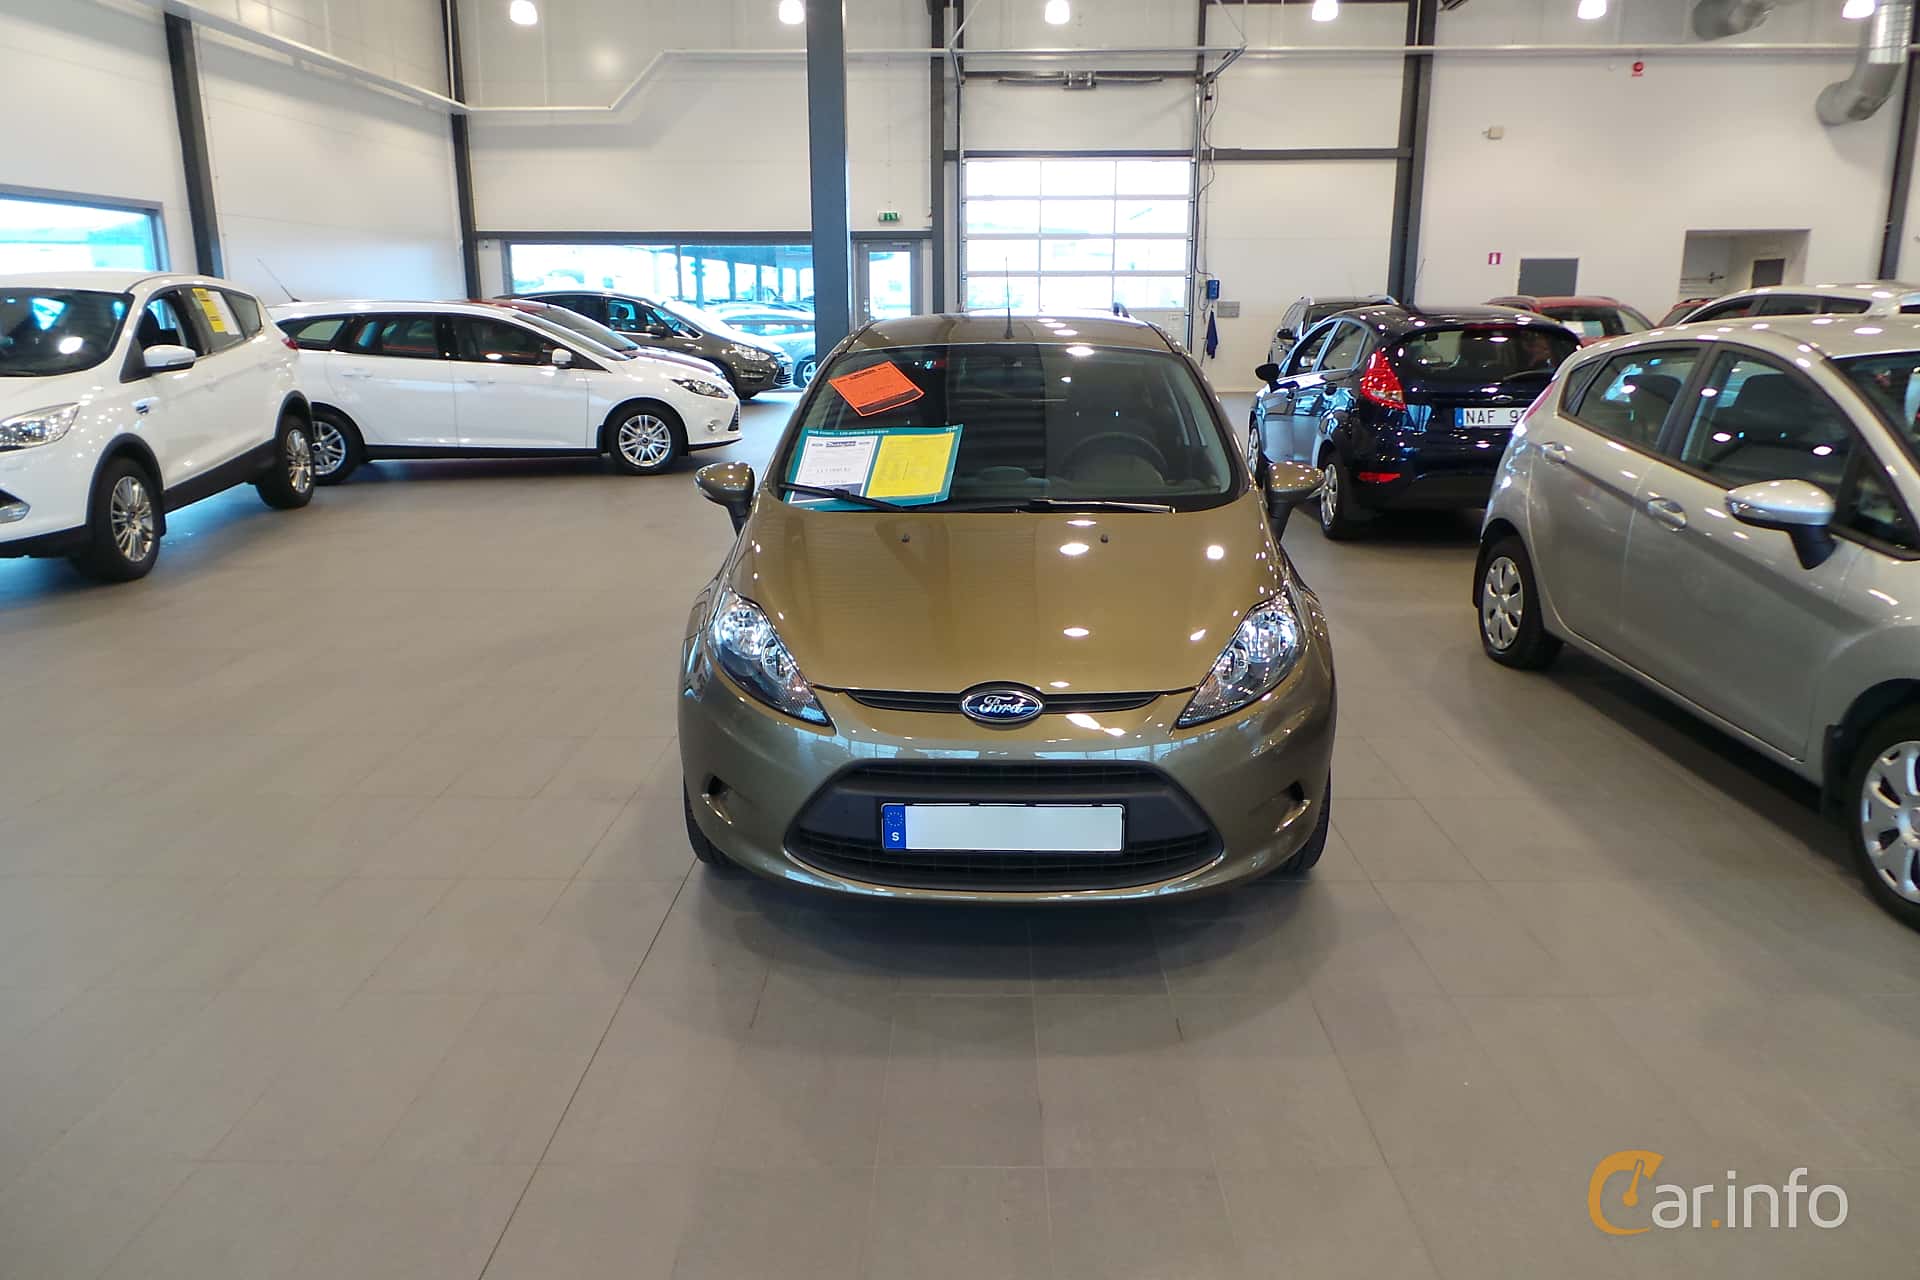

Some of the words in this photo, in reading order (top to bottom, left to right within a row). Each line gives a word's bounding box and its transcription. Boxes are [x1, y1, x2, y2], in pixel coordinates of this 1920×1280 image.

[1466, 410, 1496, 424] NAF
[979, 695, 1024, 713] Ford
[891, 832, 900, 841] S
